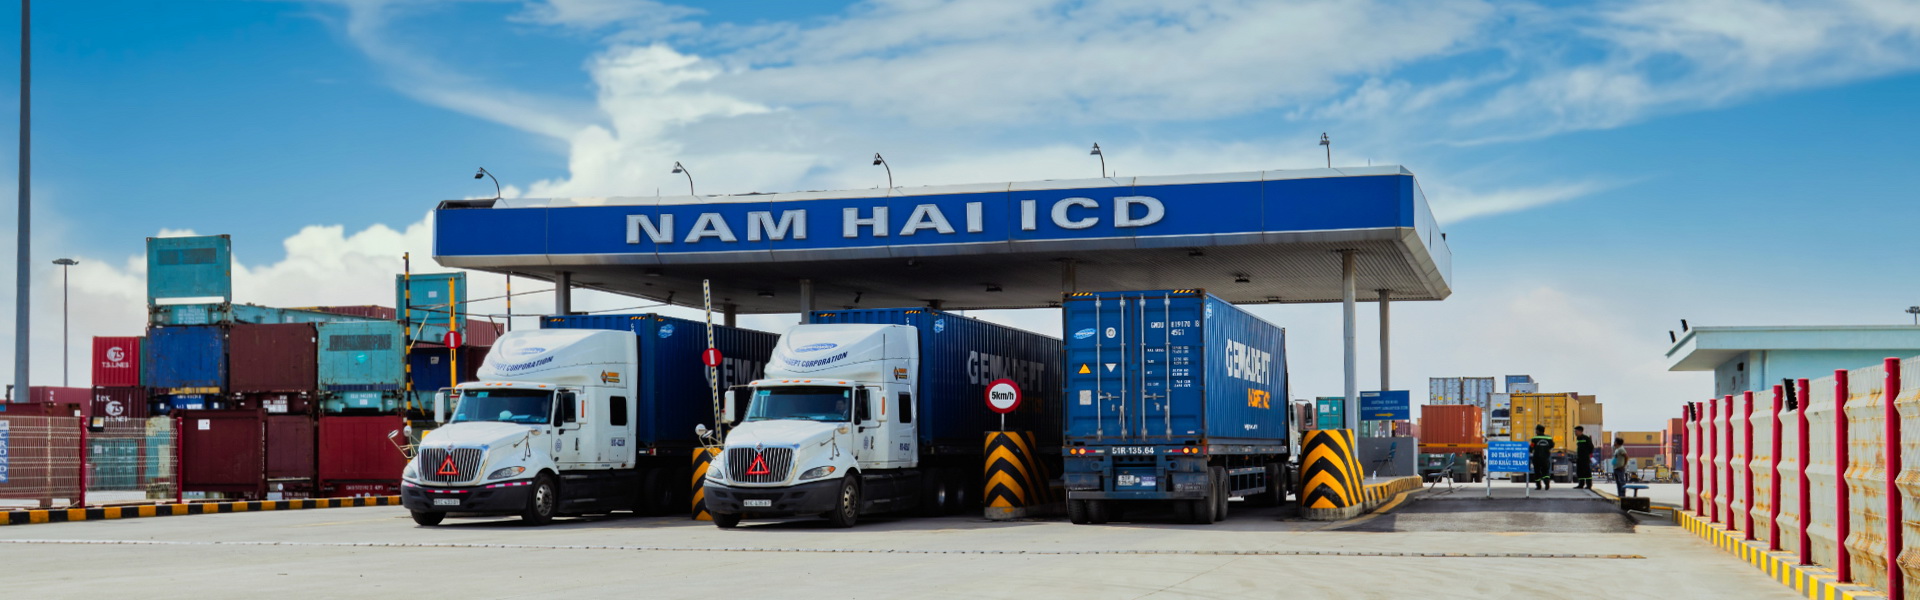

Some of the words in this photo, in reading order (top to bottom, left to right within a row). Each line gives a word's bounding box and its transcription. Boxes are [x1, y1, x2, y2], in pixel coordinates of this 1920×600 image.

[626, 208, 807, 244] NAM
[843, 201, 983, 239] HAI
[1021, 195, 1165, 231] ICD
[506, 356, 554, 372] CORPORATION
[801, 351, 848, 368] CORPORATION
[1225, 338, 1271, 386] GEMADEPT
[991, 391, 1015, 401] 5km/h
[1112, 446, 1155, 455] 51R-135.64
